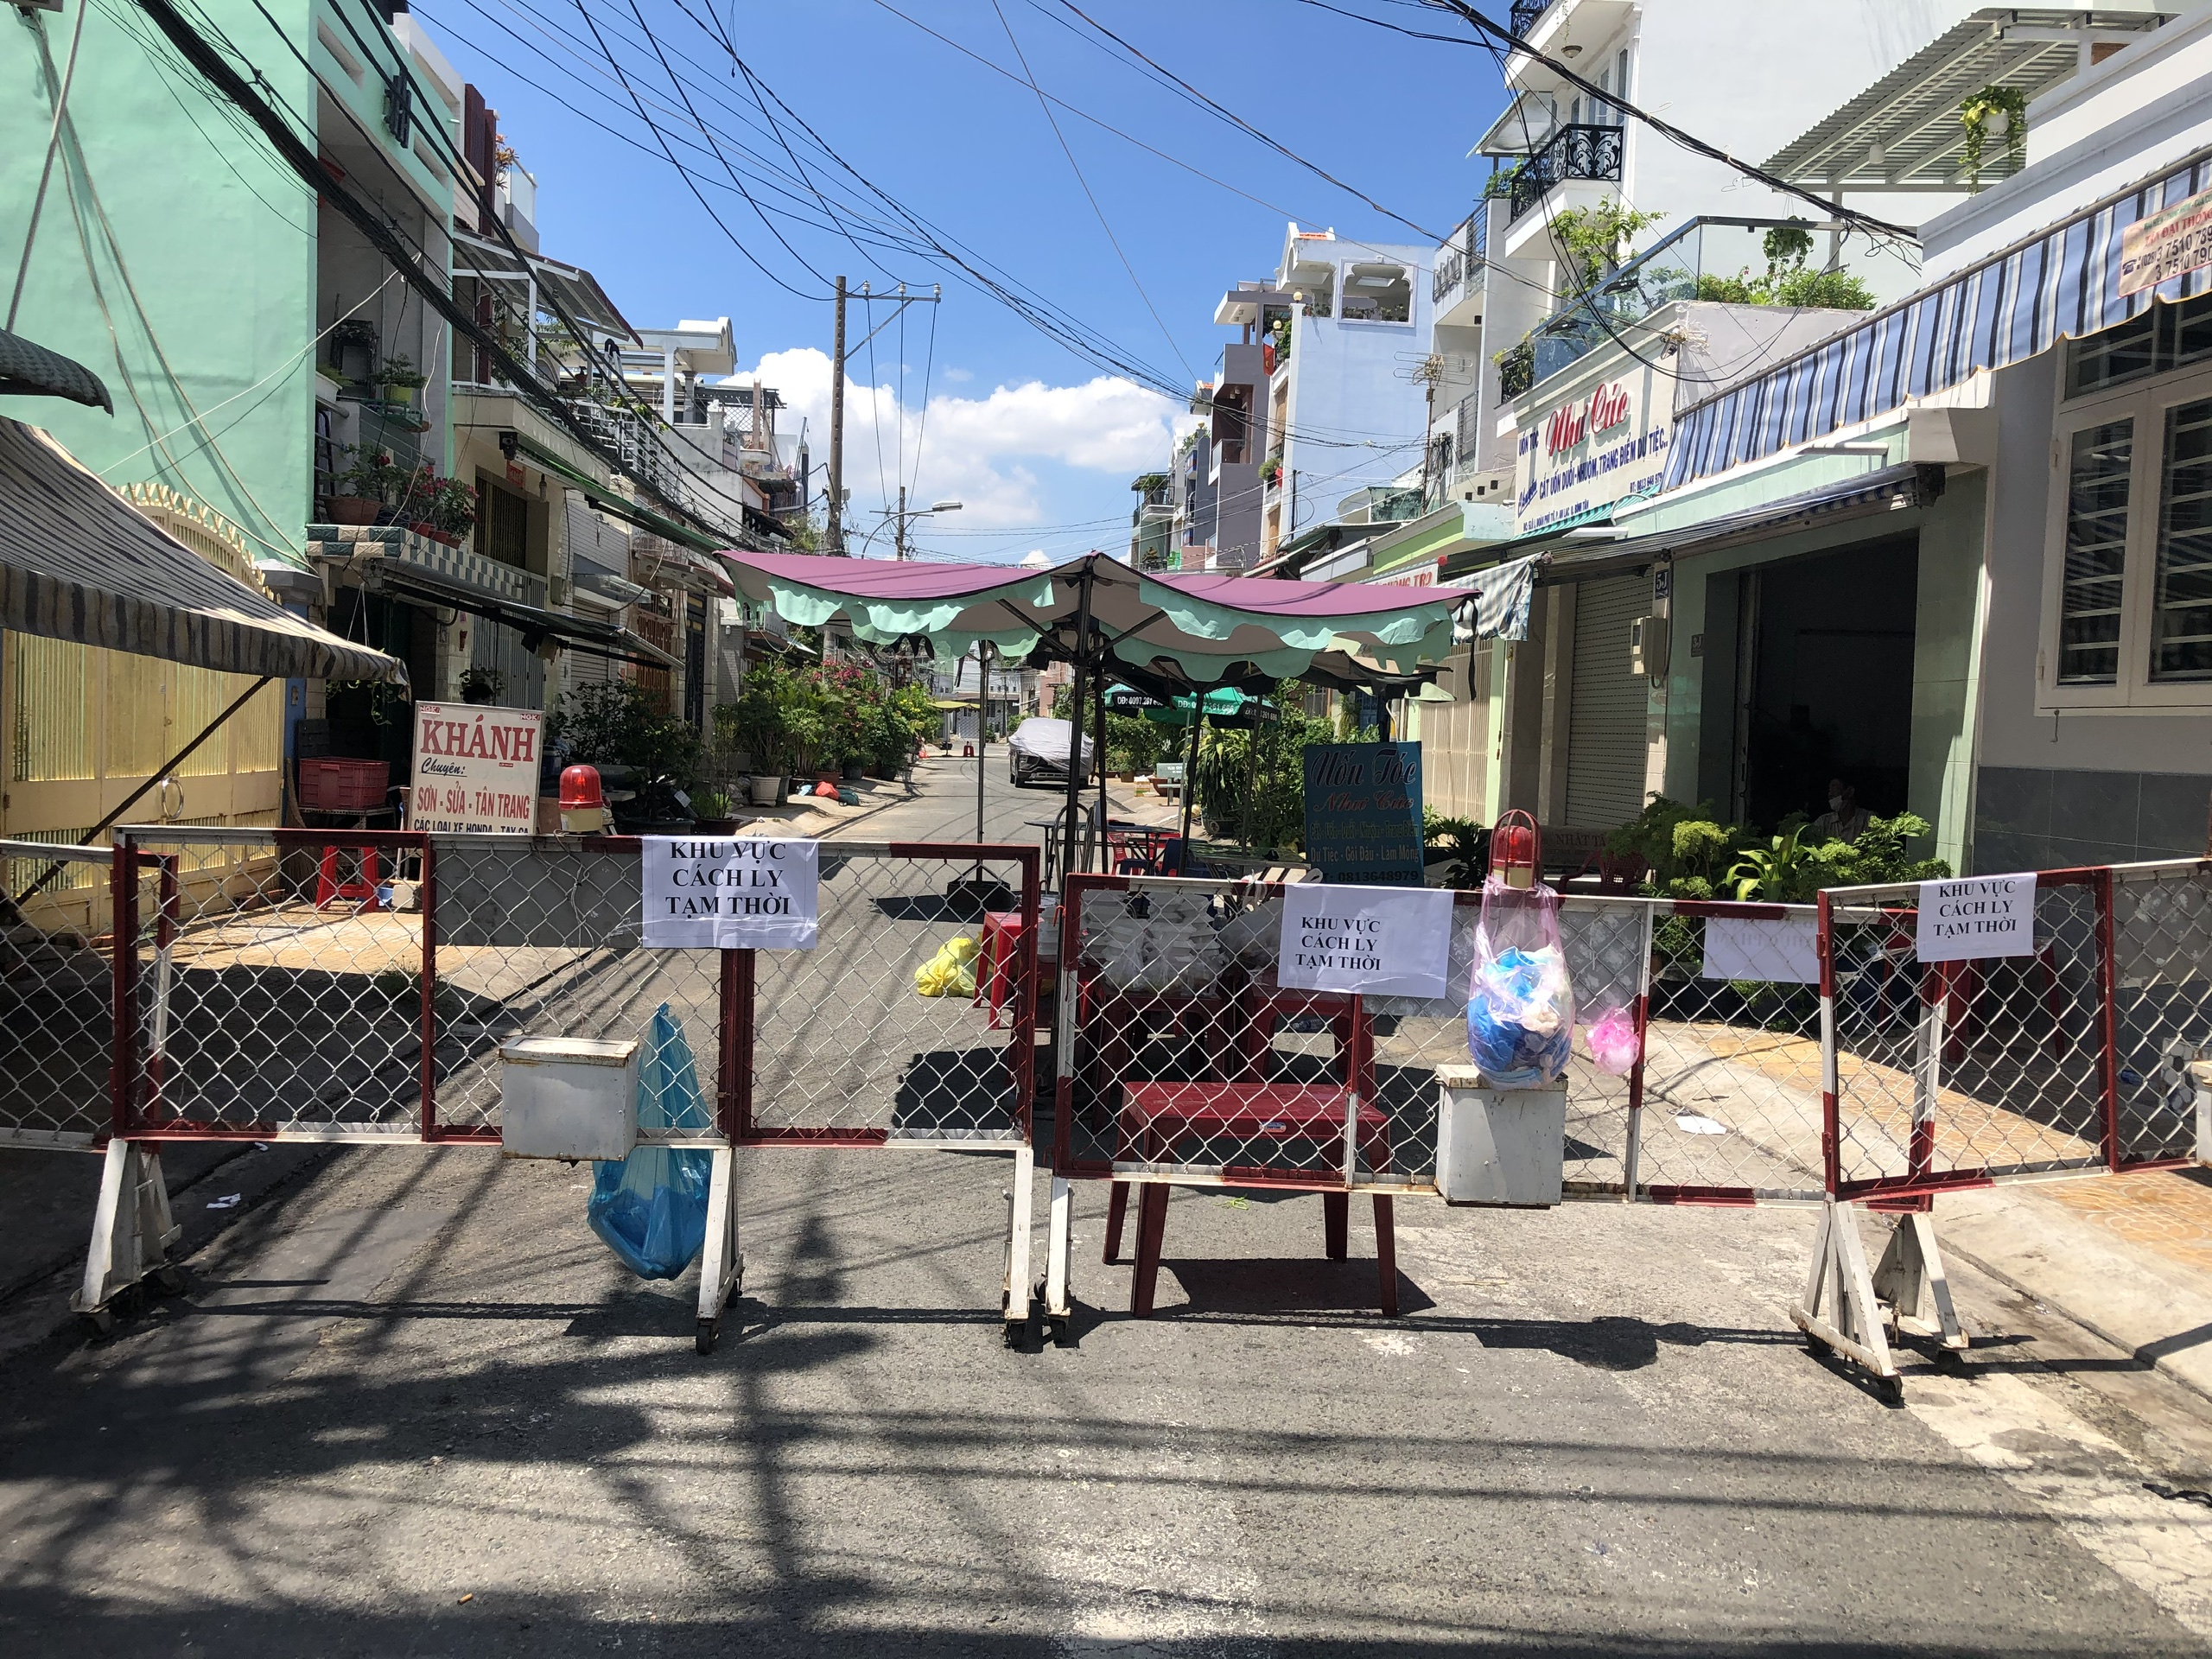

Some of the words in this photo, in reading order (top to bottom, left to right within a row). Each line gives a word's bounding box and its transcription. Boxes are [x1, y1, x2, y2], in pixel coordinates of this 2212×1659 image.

[2166, 233, 2193, 258] 7510
[2155, 264, 2162, 281] 3
[2166, 253, 2190, 276] 7510
[1547, 404, 1588, 457] Như
[1591, 384, 1628, 434] Cúc
[1599, 448, 1618, 475] TRANG
[1619, 432, 1636, 467] ĐIỂM
[1656, 571, 1669, 590] 5J
[421, 714, 536, 762] KHÁNH
[421, 757, 467, 777] Chuyên:
[1372, 748, 1417, 786] Tóc
[417, 785, 438, 812] SƠN
[446, 780, 466, 815] SỬA
[475, 786, 494, 817] TÂN
[498, 793, 530, 820] TRANG
[1313, 791, 1370, 812] Như
[414, 817, 430, 832] CÁC
[467, 823, 493, 833] HONDA
[670, 841, 725, 859] KHU
[732, 841, 786, 863] VỰC
[672, 864, 743, 887] CÁCH
[750, 869, 784, 887] LY
[1338, 870, 1419, 882] 0813648979
[1939, 884, 1974, 898] KHU
[1980, 880, 2016, 897] VỰC
[665, 896, 720, 918] TẠM
[728, 892, 791, 915] THỜI
[1939, 899, 1986, 917] CÁCH
[1992, 900, 2013, 914] LY
[1301, 916, 1338, 931] KHU
[1343, 918, 1381, 935] VỰC
[1933, 922, 1970, 938] TẠM
[1974, 917, 2017, 933] THỜI
[1301, 932, 1350, 950] CÁCH
[1356, 938, 1377, 952] LY
[1295, 953, 1332, 969] TẠM
[1338, 954, 1382, 971] THỜI
